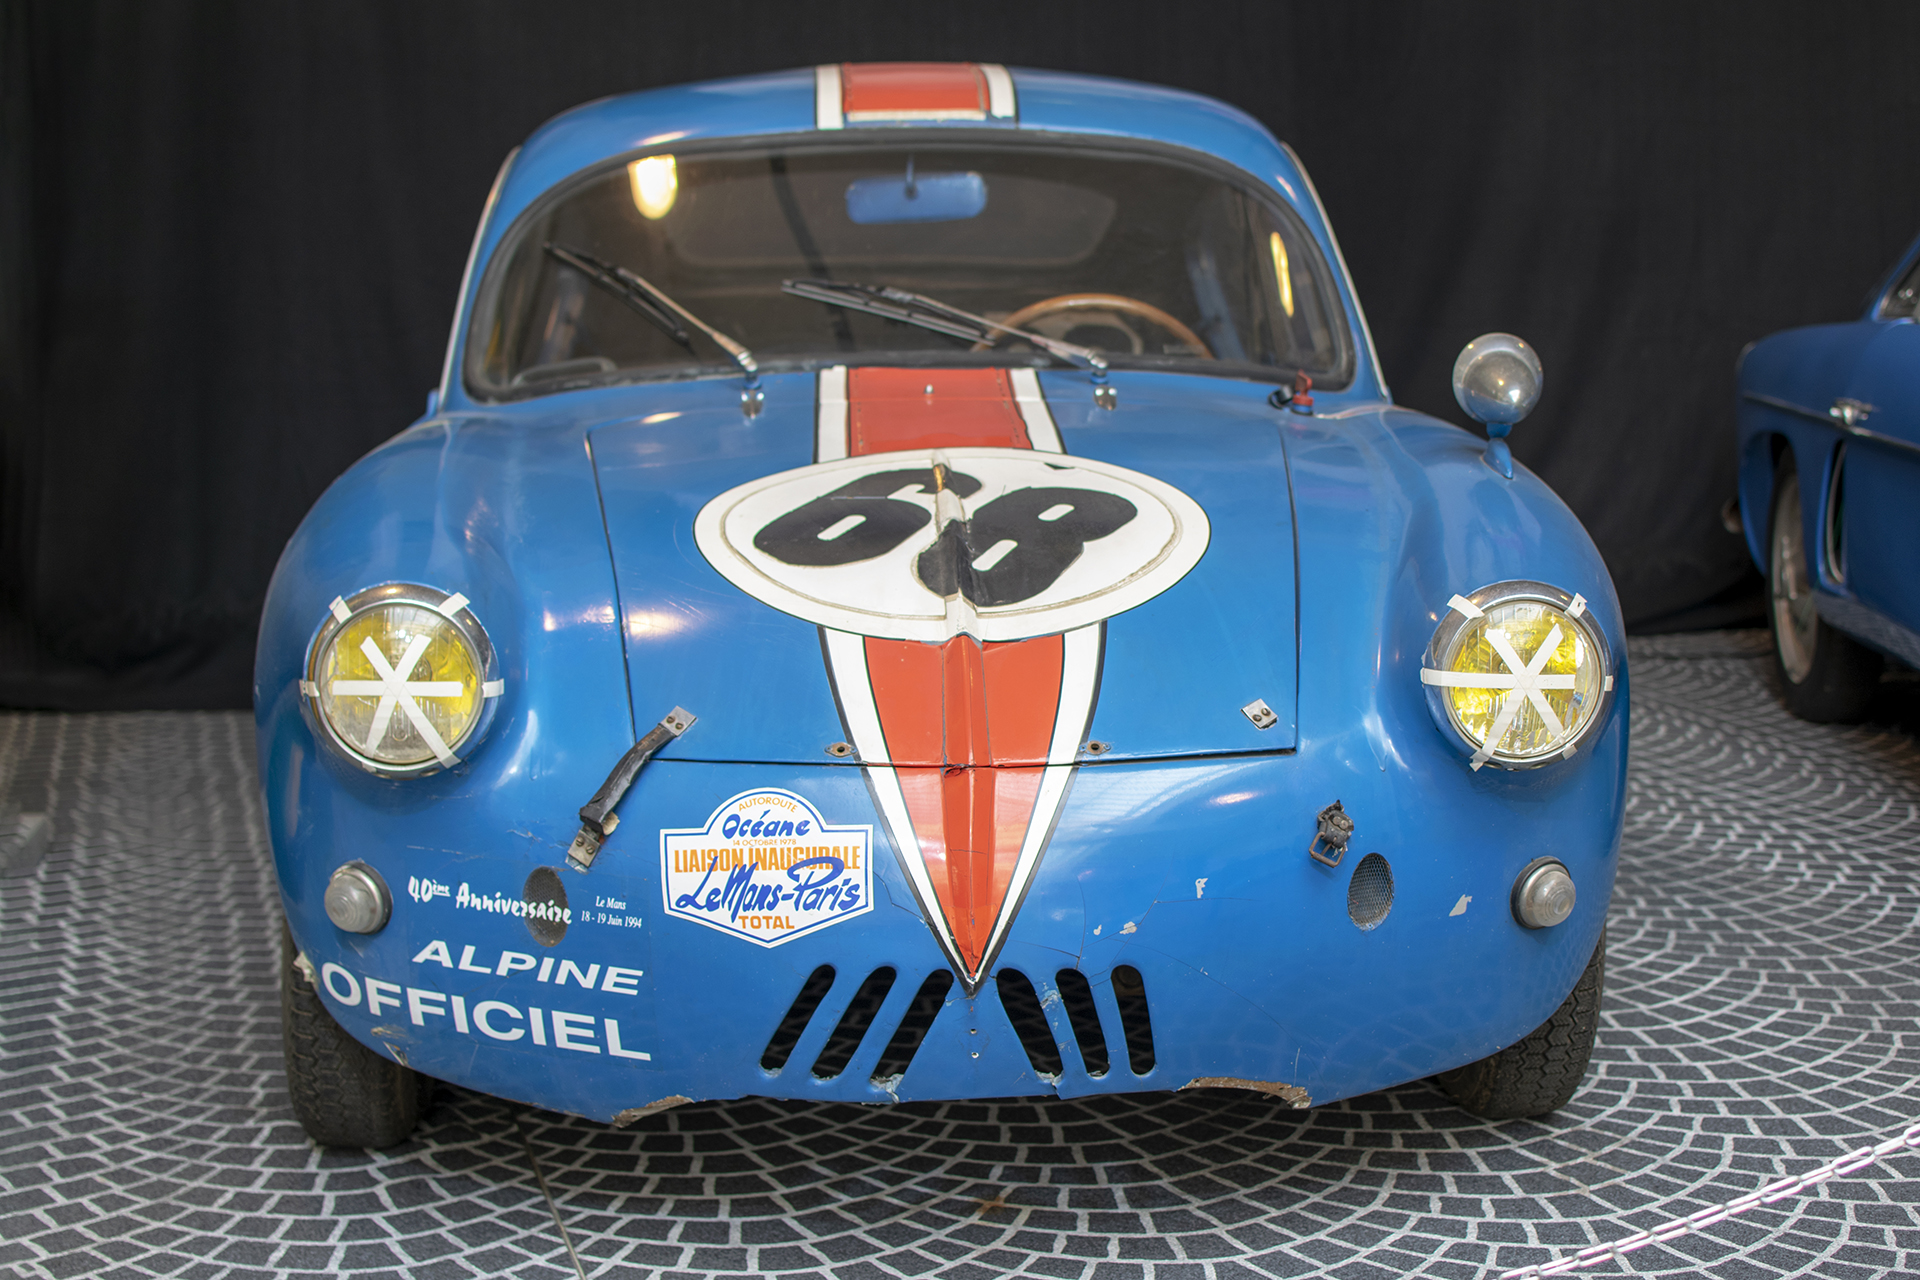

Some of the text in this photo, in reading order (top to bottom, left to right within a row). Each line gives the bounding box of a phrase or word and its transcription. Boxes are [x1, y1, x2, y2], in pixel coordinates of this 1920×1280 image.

[753, 468, 1139, 608] 68
[738, 796, 798, 813] AUTOROUTE
[722, 809, 811, 840] Océane
[732, 838, 797, 847] 14 OCTOBRE 1978
[674, 845, 861, 874] LIAISON INAUGURALE
[455, 881, 573, 925] Anniversaire
[595, 895, 627, 911] Le Mans
[581, 909, 591, 923] 18
[597, 911, 607, 924] 19
[607, 913, 623, 927] Juin
[624, 915, 643, 929] 1994
[738, 915, 796, 930] TOTAL
[411, 939, 644, 996] ALPINE
[321, 961, 652, 1062] OFFICIEL
